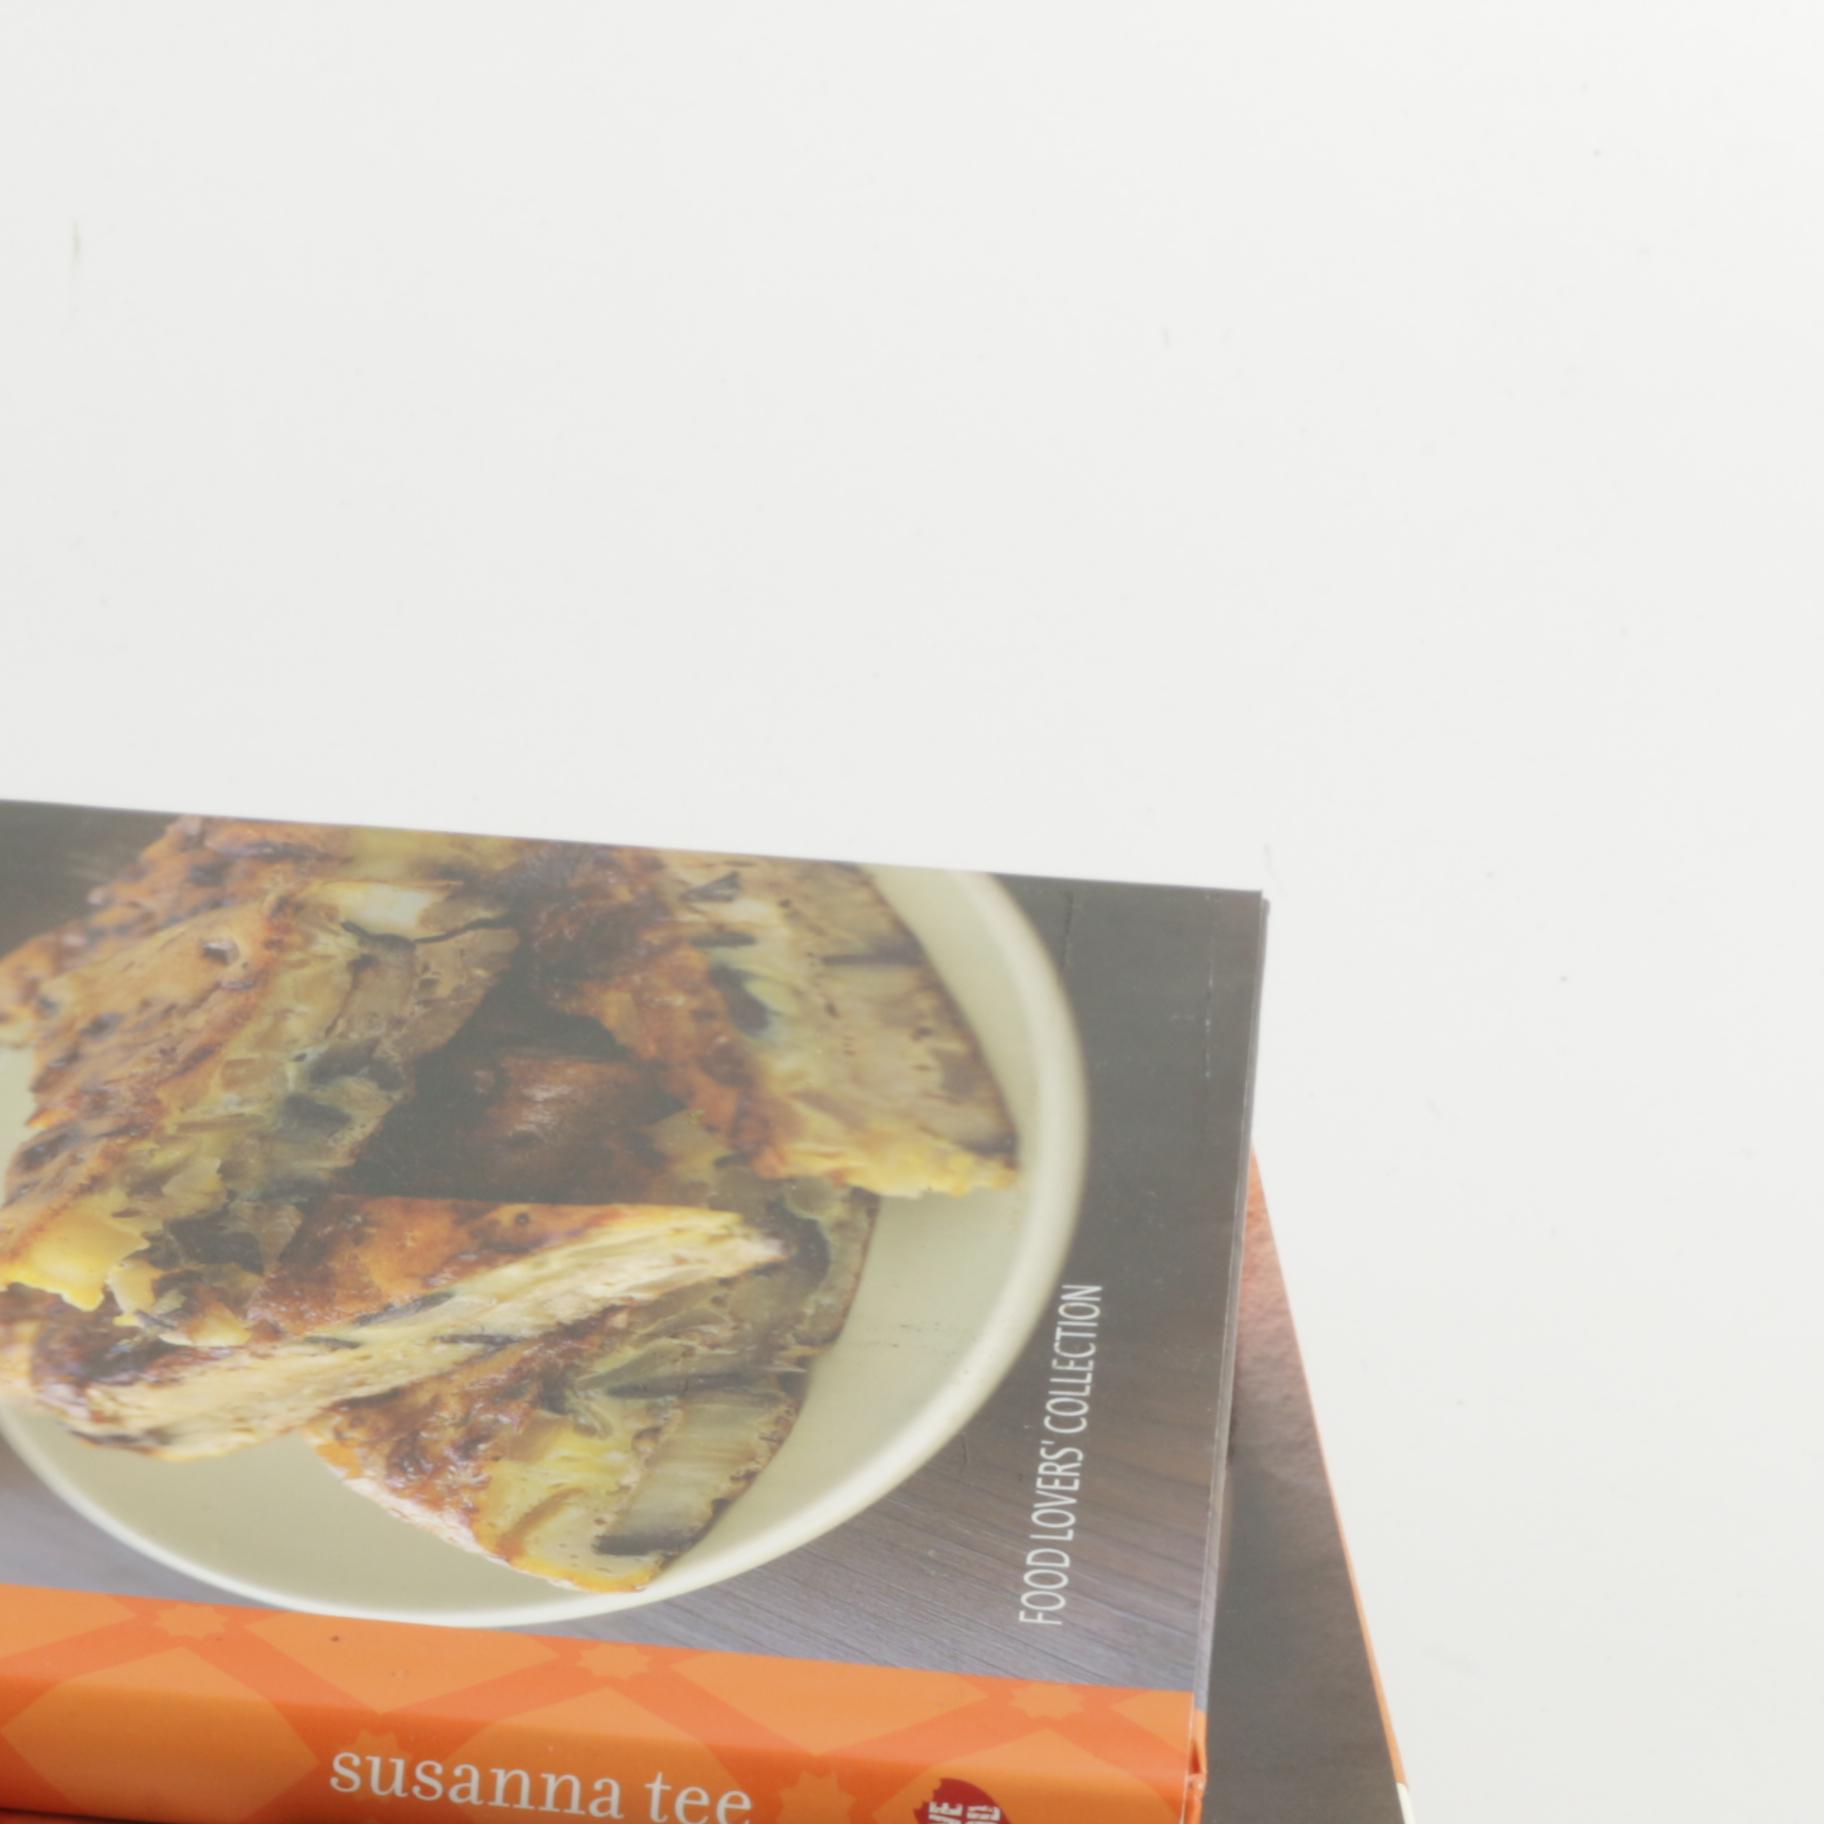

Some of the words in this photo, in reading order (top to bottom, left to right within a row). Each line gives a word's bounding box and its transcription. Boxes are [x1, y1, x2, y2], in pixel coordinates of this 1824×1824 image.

[1043, 1284, 1103, 1434] COLLECTION
[1029, 1439, 1084, 1542] LOVERS'
[1019, 1547, 1071, 1625] FOOD
[328, 1750, 624, 1820] susanna
